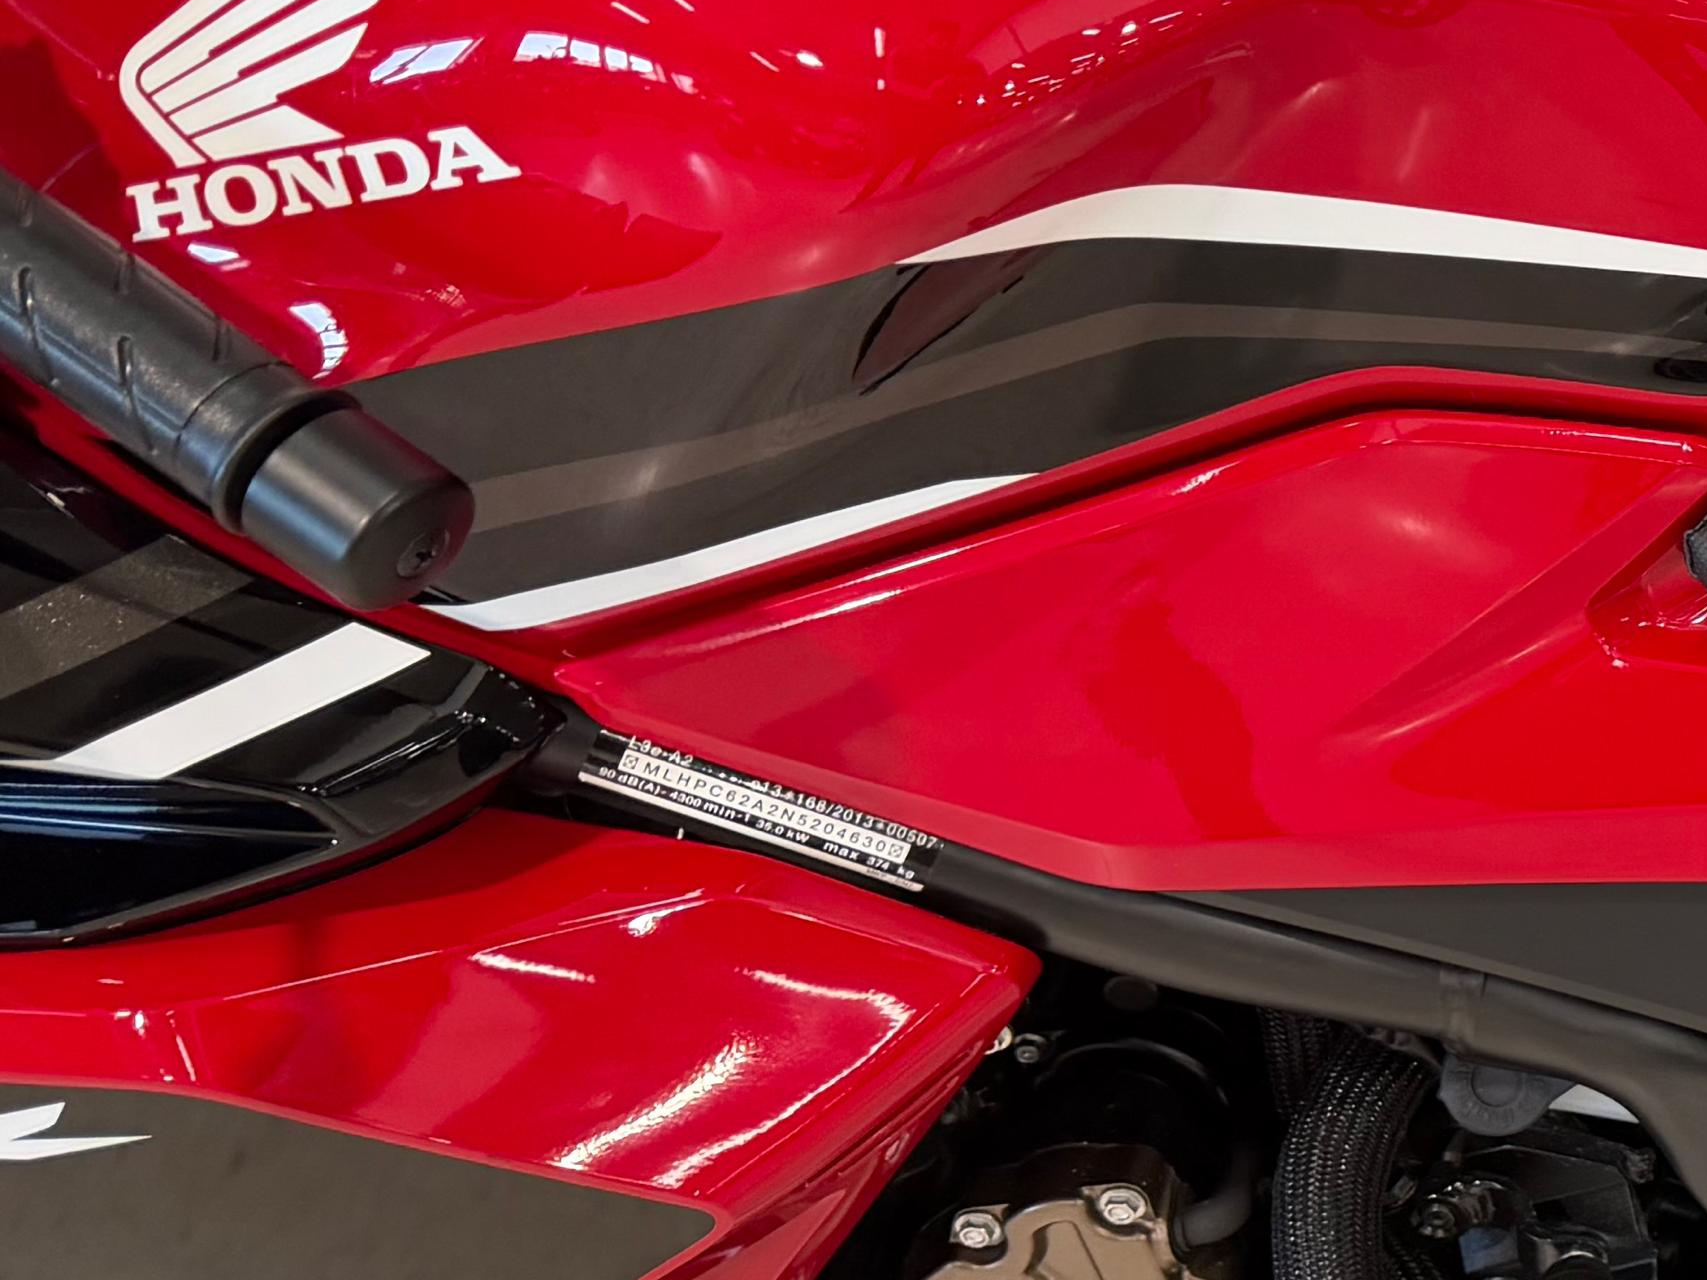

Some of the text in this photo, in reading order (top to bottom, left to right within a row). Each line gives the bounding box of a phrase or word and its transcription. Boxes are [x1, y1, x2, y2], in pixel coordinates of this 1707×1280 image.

[126, 125, 522, 242] HONDA
[786, 828, 811, 844] kW
[822, 840, 861, 861] max
[897, 864, 917, 880] kg
